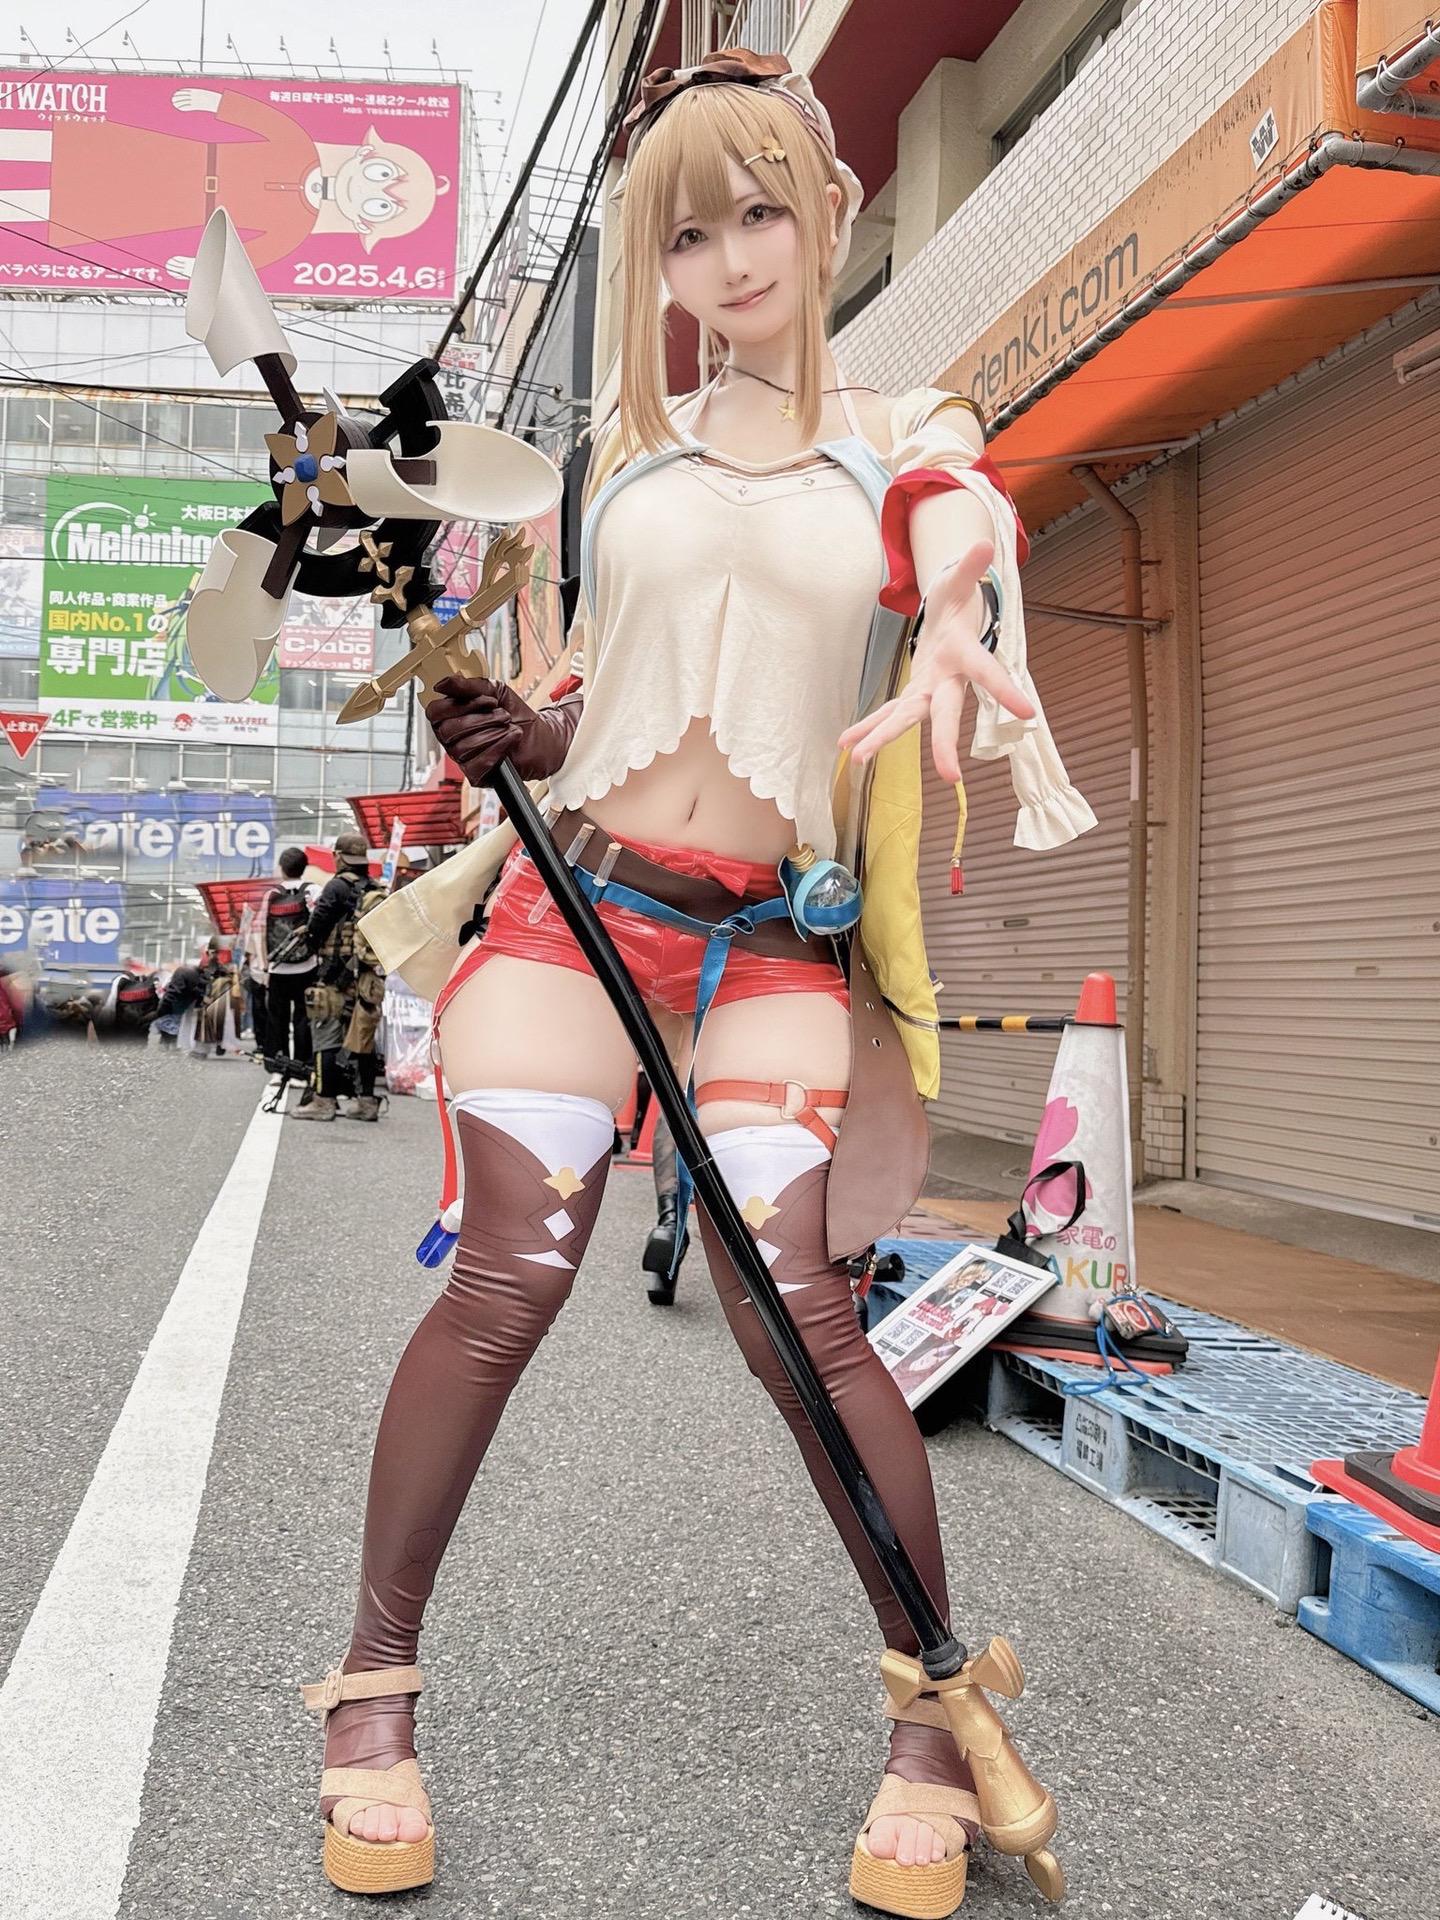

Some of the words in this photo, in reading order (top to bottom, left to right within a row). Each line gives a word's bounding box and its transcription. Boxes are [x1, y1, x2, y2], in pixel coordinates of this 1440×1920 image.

[293, 262, 437, 290] 2025.4.6
[67, 522, 219, 568] Melonbo
[49, 590, 167, 608] 同人作品・商業作品
[46, 635, 167, 678] 専門店
[7, 720, 39, 732] 止まれ
[52, 709, 158, 730] 4Fで営業中
[1056, 1224, 1117, 1251] 家電の
